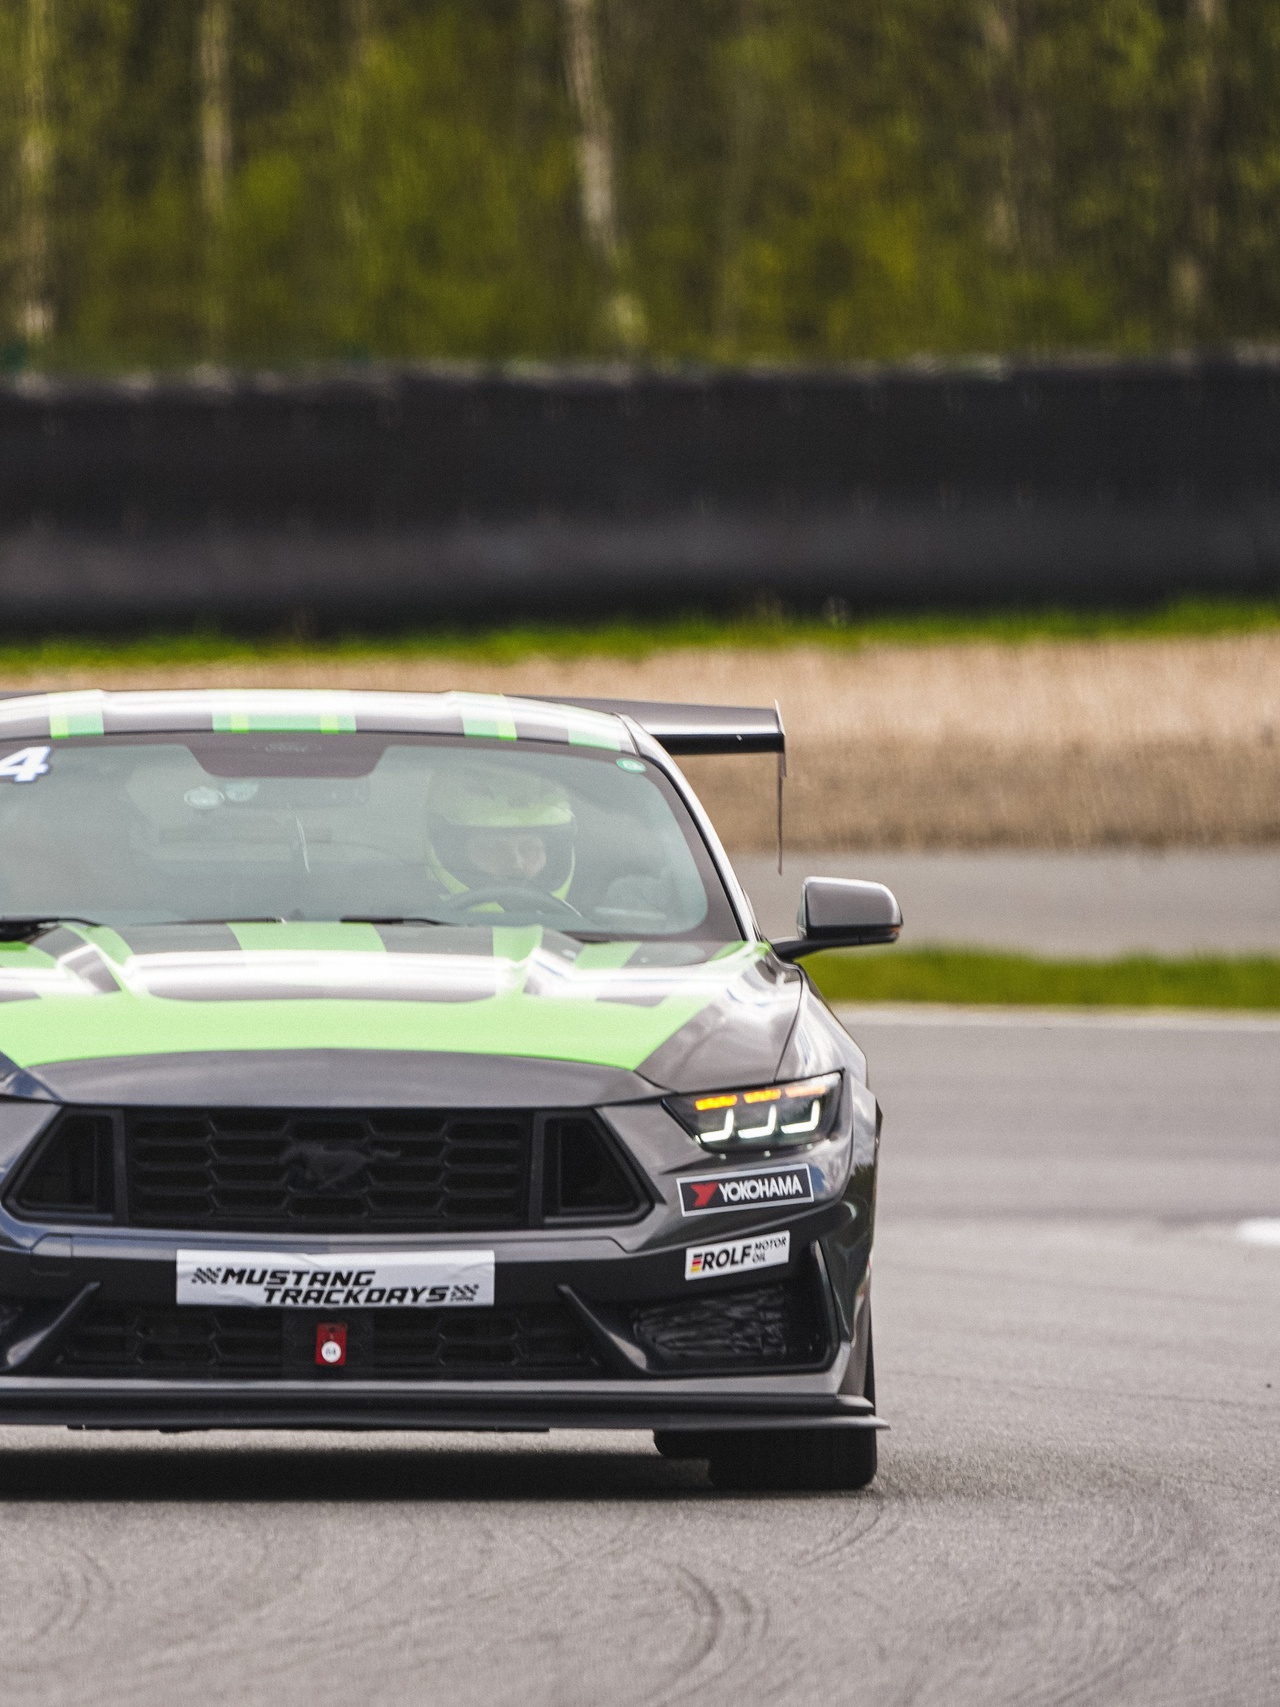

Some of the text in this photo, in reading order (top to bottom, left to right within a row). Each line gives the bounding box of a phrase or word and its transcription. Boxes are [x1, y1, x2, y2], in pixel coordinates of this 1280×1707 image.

[718, 1174, 804, 1203] YOKOHAMA
[702, 1237, 787, 1271] ROLF MOTOR
[221, 1268, 376, 1287] MUSTANG
[264, 1286, 450, 1305] TRACKDAYS
